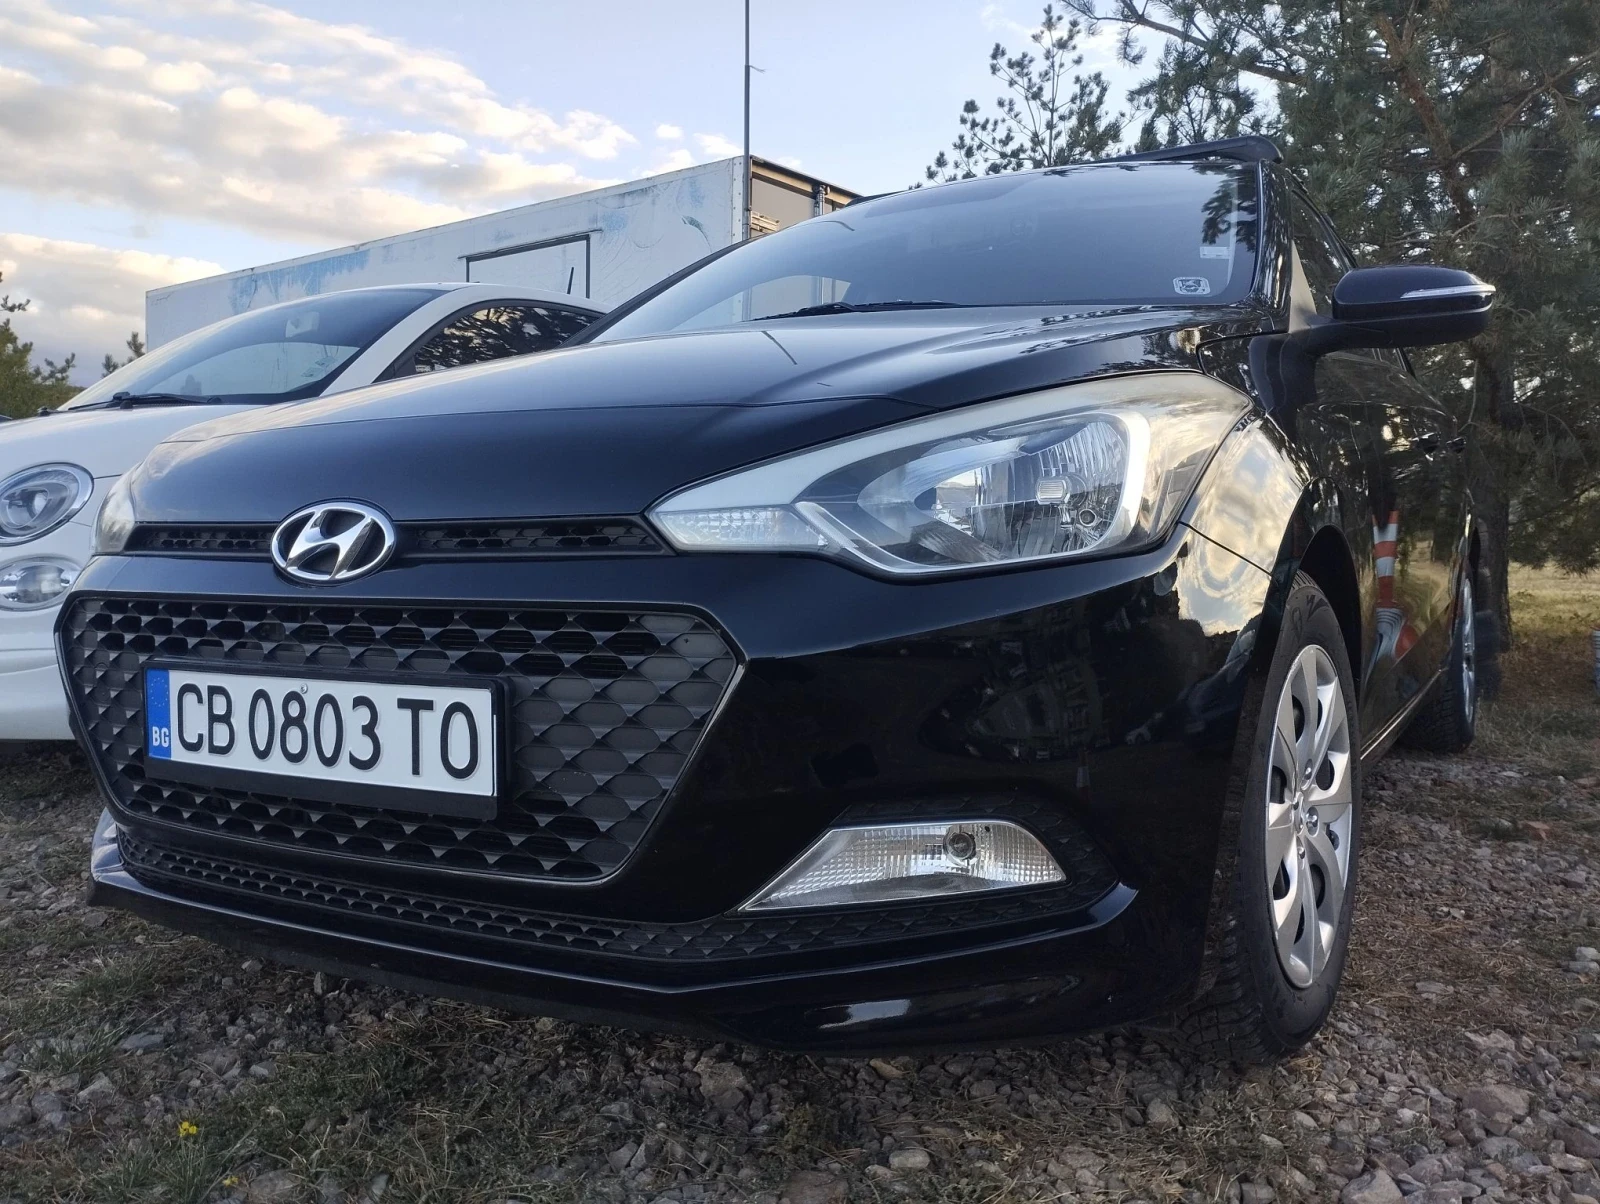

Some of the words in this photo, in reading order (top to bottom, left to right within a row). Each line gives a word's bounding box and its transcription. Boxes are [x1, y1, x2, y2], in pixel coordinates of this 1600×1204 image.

[152, 726, 170, 748] BG
[176, 683, 235, 755] CB
[249, 688, 382, 770] 0803
[396, 697, 479, 779] TO
